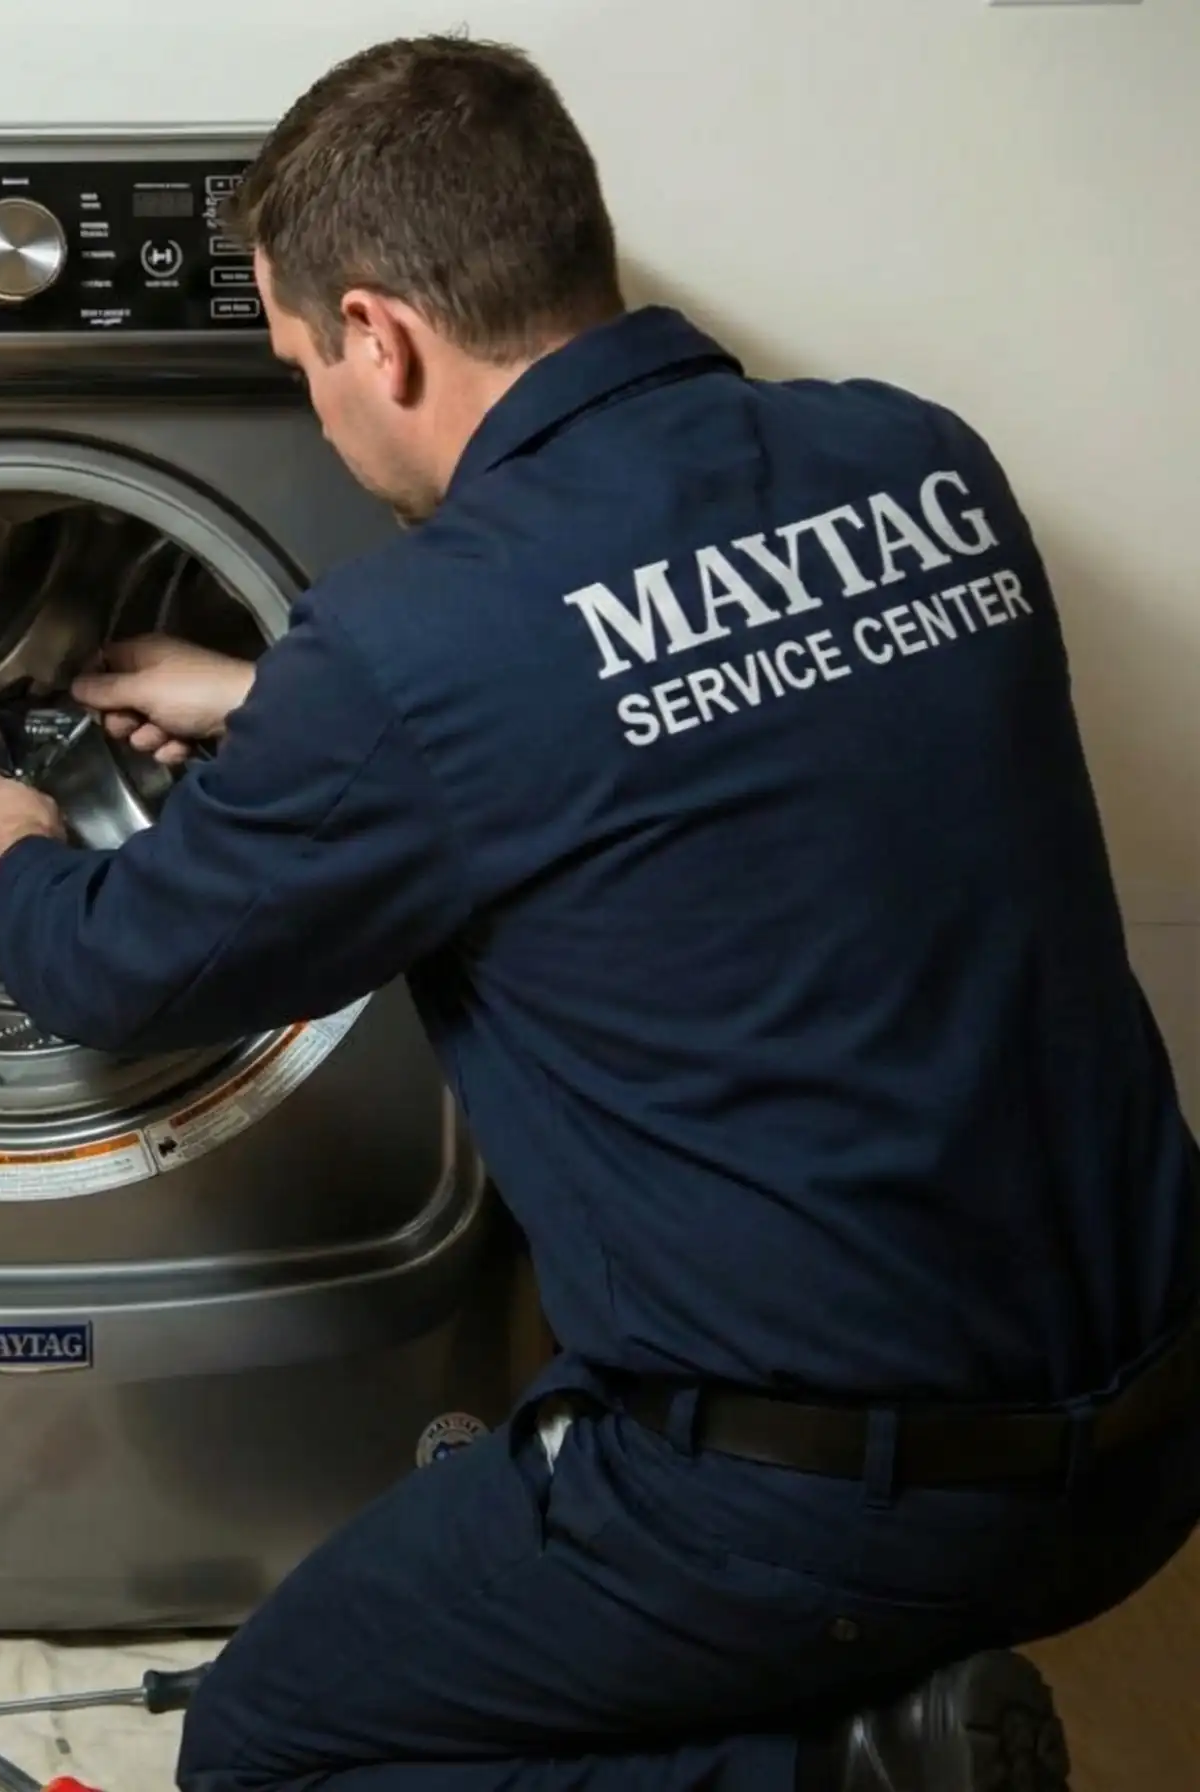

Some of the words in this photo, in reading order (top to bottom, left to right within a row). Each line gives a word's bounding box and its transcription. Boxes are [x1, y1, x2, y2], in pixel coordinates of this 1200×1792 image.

[562, 470, 999, 679] MAYTAG
[617, 630, 852, 746] SERVICE
[853, 569, 1033, 664] CENTER
